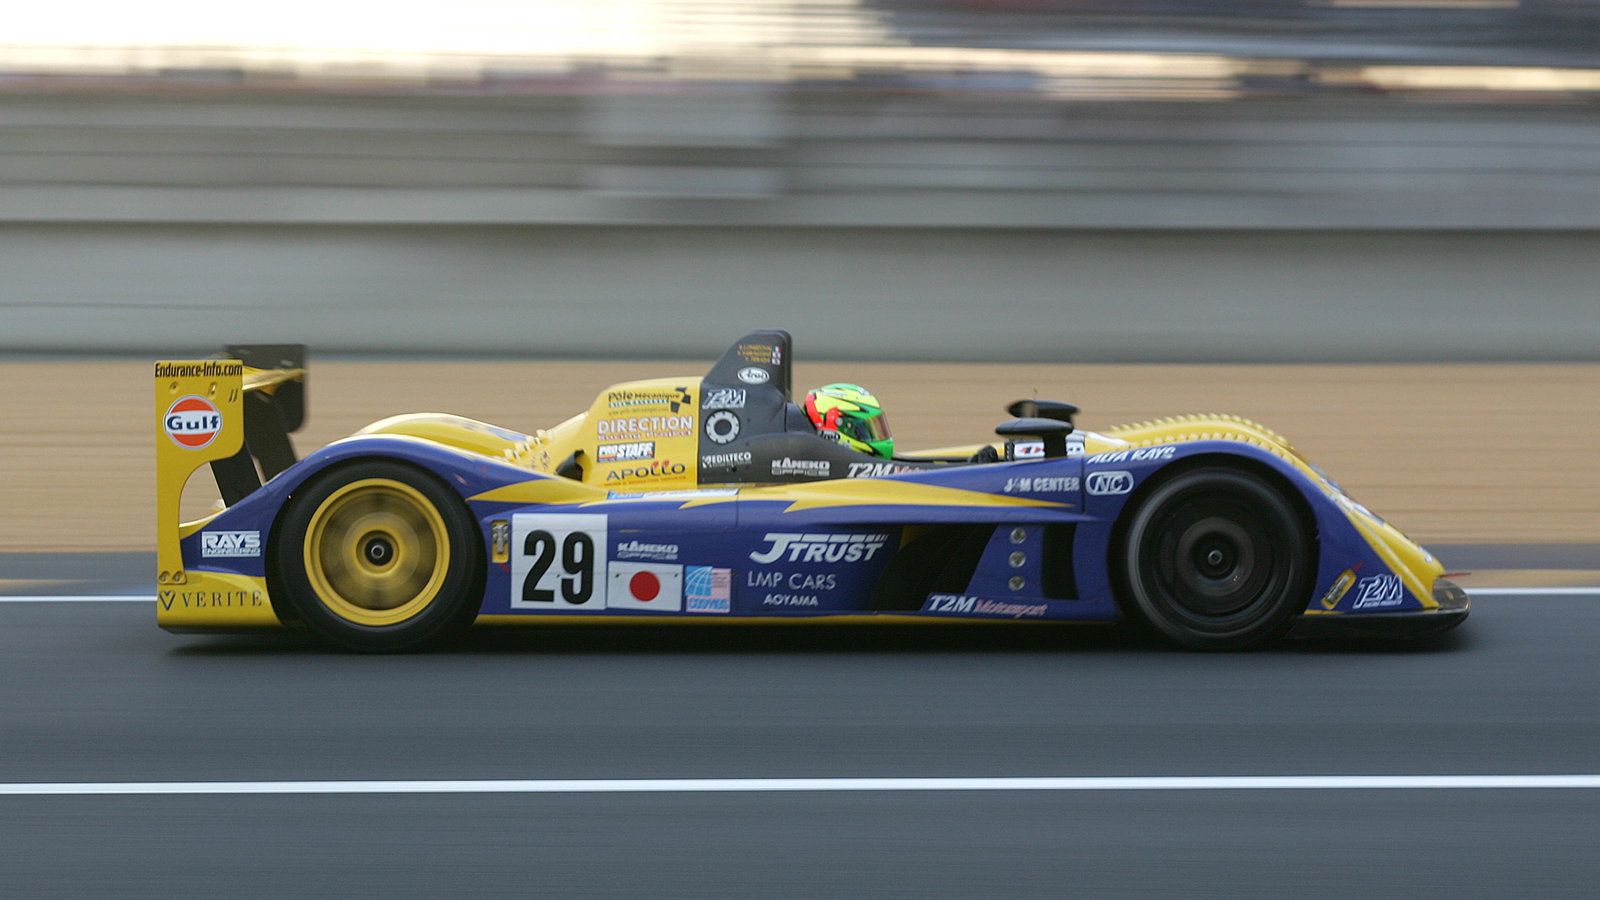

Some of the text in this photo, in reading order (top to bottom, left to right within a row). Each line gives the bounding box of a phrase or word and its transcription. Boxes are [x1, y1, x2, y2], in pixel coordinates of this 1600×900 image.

[155, 361, 243, 378] Endurance-Info.com
[166, 416, 219, 431] Gulf
[598, 416, 693, 435] DIRECTION
[606, 461, 686, 481] APOLLO
[1033, 477, 1080, 492] CENTER
[202, 531, 261, 548] RAYS
[522, 529, 595, 605] 29
[747, 570, 783, 588] LMP
[788, 573, 836, 590] CARS
[763, 593, 819, 607] AOYAMA
[1352, 574, 1403, 609] T2M
[928, 594, 977, 613] T2M
